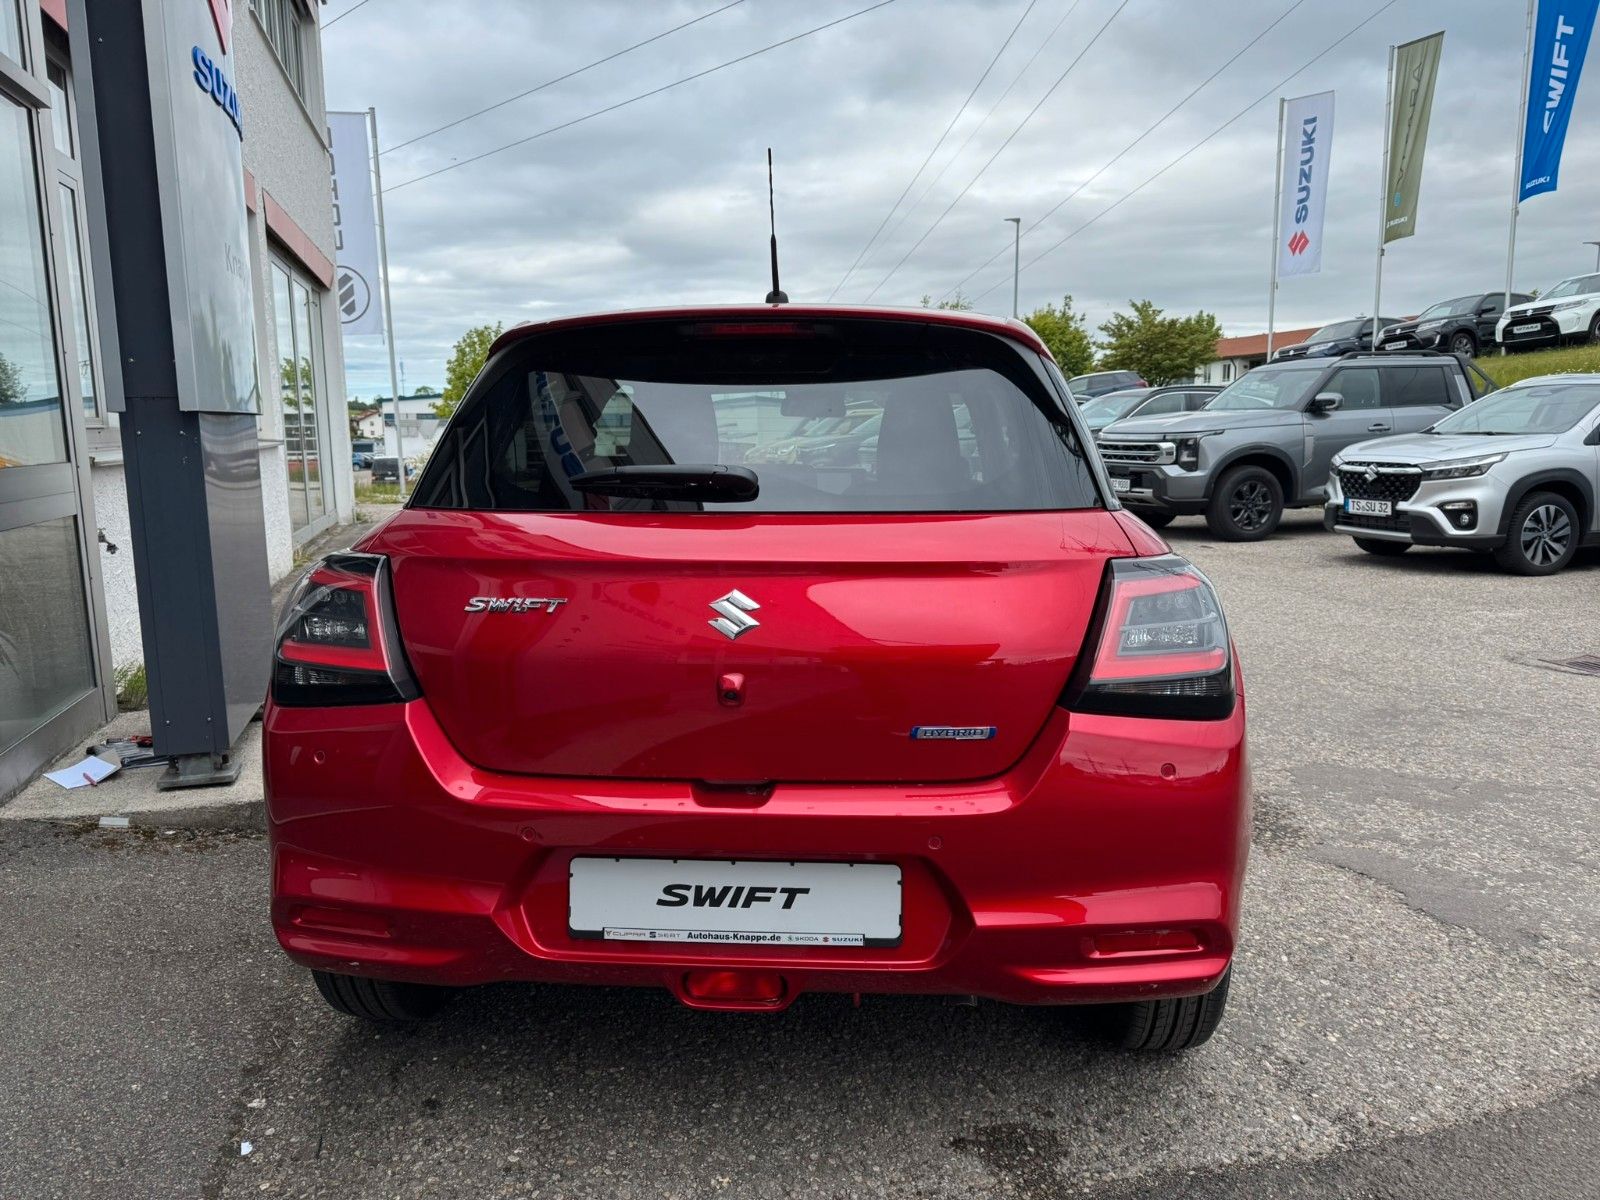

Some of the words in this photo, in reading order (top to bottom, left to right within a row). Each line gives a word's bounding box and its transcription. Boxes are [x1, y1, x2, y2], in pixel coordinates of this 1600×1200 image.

[1295, 116, 1317, 224] SUZUKI
[1351, 500, 1361, 511] TS
[1365, 501, 1376, 512] SU
[1378, 502, 1388, 513] 32
[464, 596, 568, 613] SWIFT
[656, 884, 810, 909] SWIFT
[687, 931, 781, 943] Autohaus-Knappe.de
